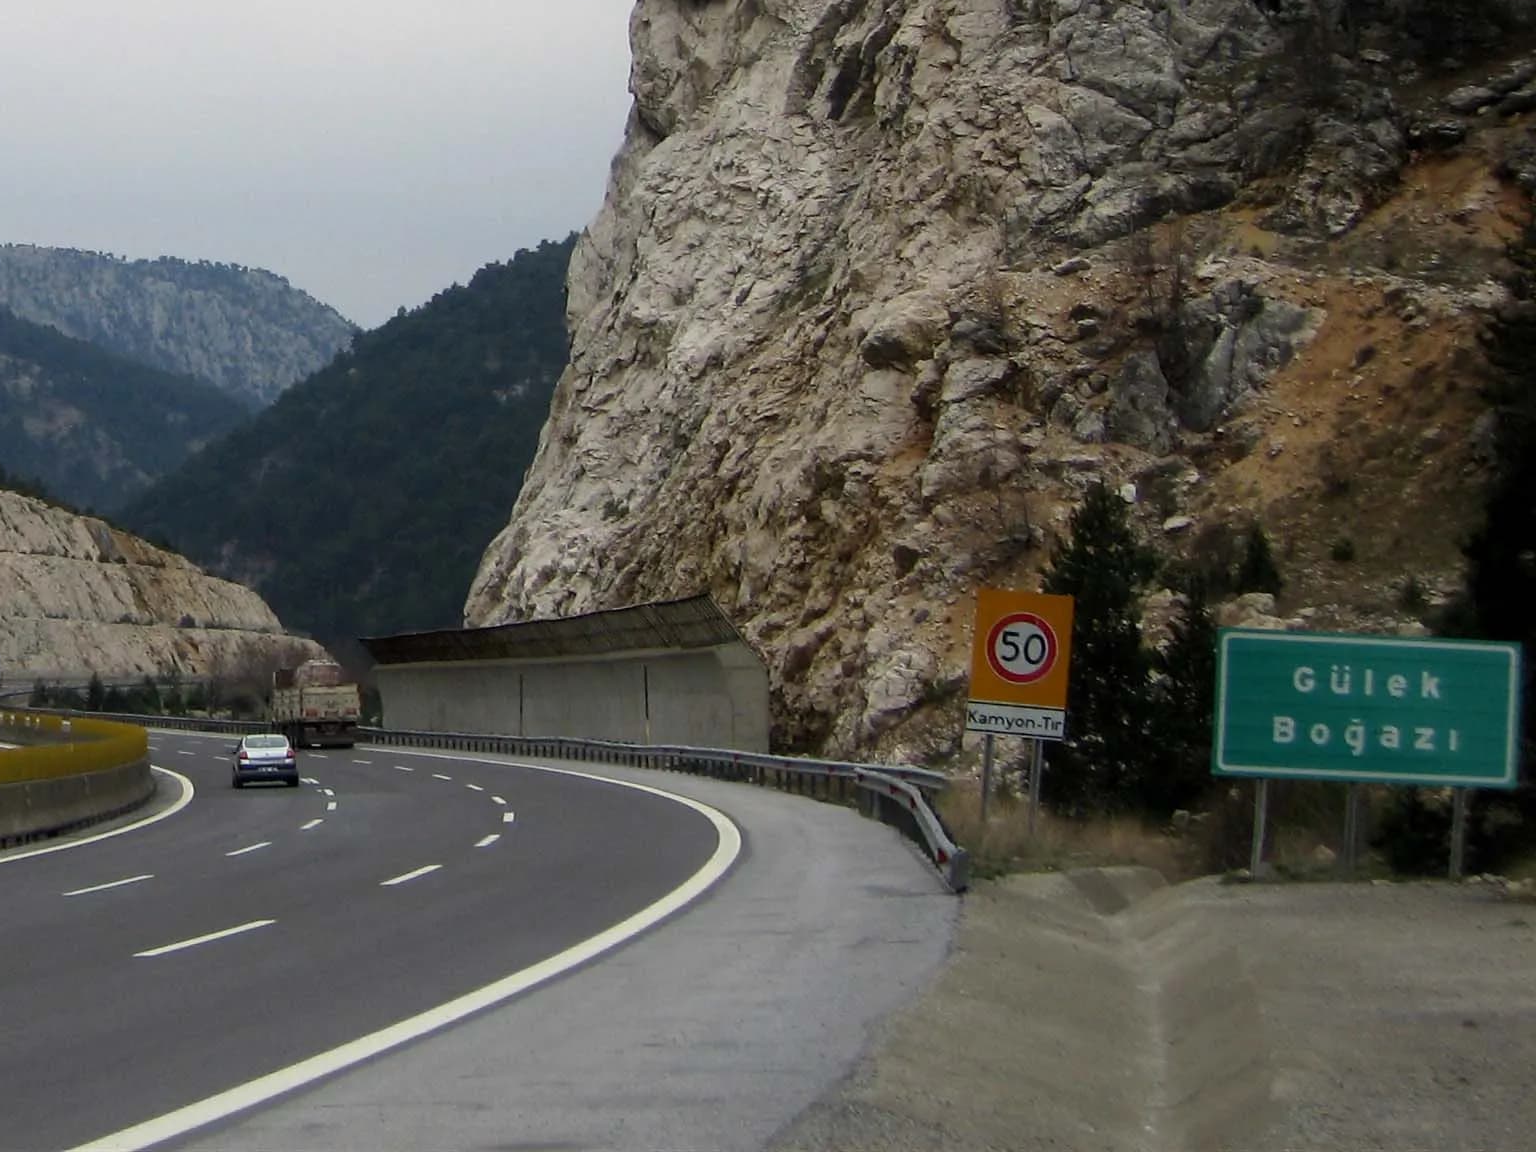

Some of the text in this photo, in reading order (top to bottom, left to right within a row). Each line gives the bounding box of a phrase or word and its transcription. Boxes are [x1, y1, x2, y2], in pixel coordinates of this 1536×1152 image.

[1001, 631, 1046, 665] 50
[1293, 665, 1440, 698] Gülek
[1273, 716, 1458, 756] Boğazı
